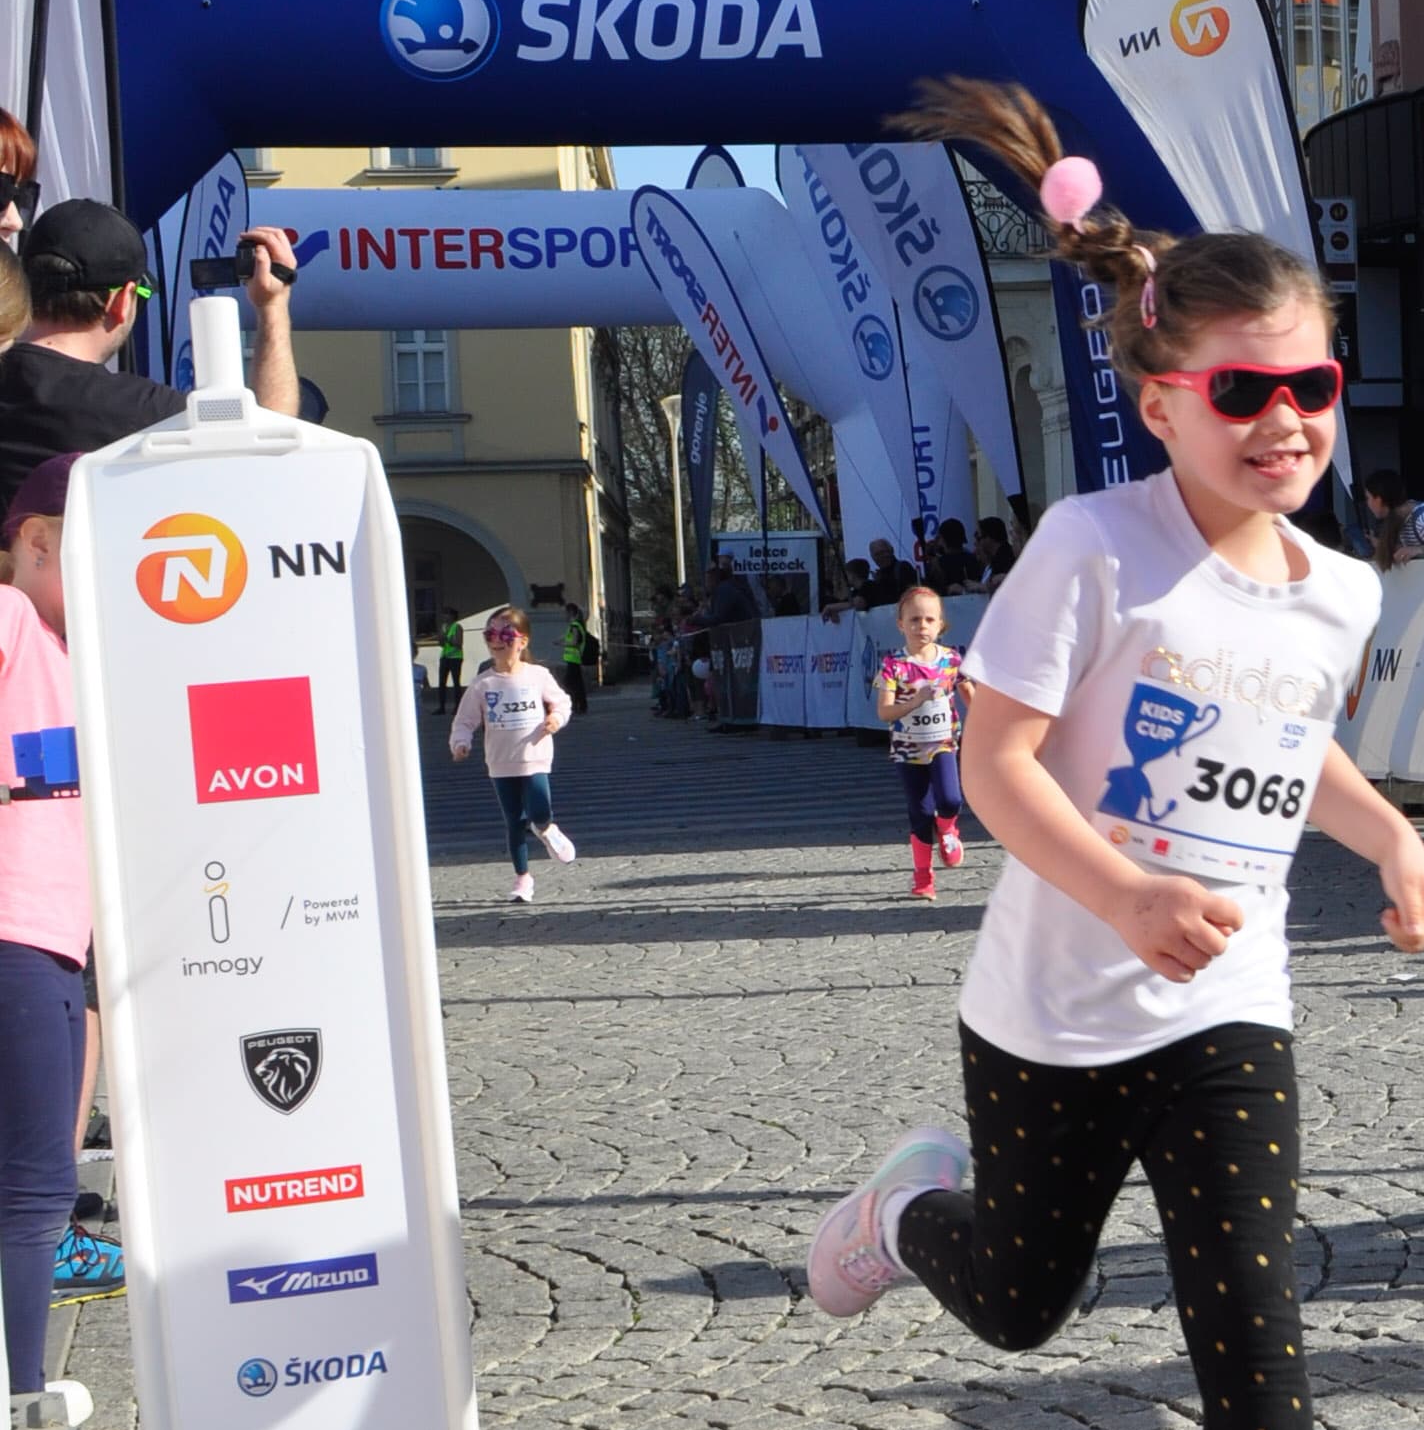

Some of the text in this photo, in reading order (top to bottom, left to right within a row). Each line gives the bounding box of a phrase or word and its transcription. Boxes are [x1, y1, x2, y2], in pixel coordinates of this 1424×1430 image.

[1077, 263, 1131, 488] EUGEO
[689, 391, 708, 466] gorenje
[267, 540, 347, 579] NN
[750, 546, 788, 558] lekce
[733, 558, 806, 572] hitchcock
[1370, 649, 1402, 682] NN
[501, 700, 537, 714] 3234
[1138, 699, 1186, 726] KIDS
[911, 713, 947, 727] 3061
[1135, 721, 1177, 743] CUP
[208, 762, 305, 793] AVON
[1186, 756, 1306, 820] 3068
[303, 895, 360, 910] Powered
[304, 908, 360, 927] by MVM
[182, 954, 264, 978] innogy
[247, 1034, 314, 1049] PEUGEOT
[232, 1173, 358, 1206] NUTREND
[284, 1350, 388, 1387] ŠKODA
